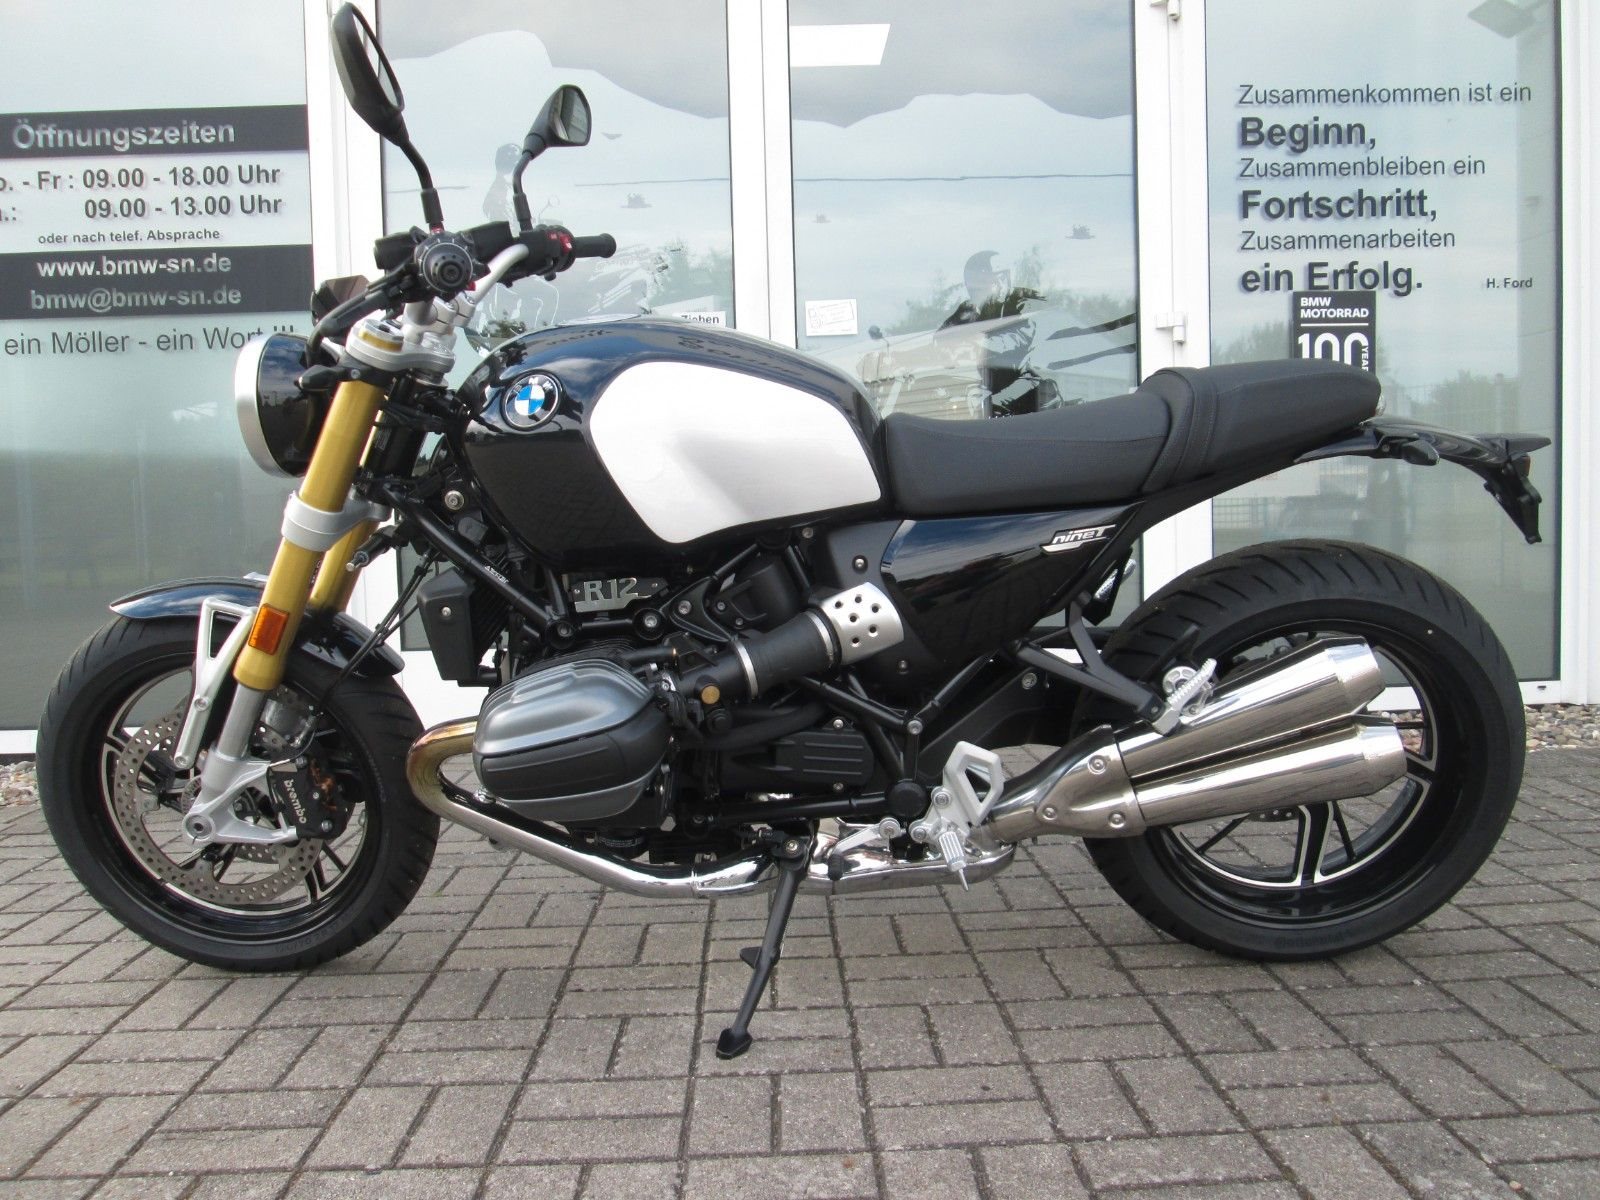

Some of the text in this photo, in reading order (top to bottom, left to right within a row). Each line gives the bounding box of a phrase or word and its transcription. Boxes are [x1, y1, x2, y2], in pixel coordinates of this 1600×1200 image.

[1238, 83, 1532, 105] Zusammenkommen ist ein
[13, 119, 235, 151] Öffnungszeiten
[1240, 116, 1377, 152] Beginn,
[82, 168, 145, 189] 09.00
[169, 165, 229, 186] 18.00
[237, 164, 281, 184] Uhr
[1239, 156, 1486, 178] Zusammenbleiben ein
[84, 198, 146, 219] 09.00
[171, 194, 231, 216] 13.00
[239, 194, 283, 214] Uhr
[1241, 188, 1437, 222] Fortschritt,
[38, 228, 220, 244] oder nach telef. Absprache
[1240, 229, 1456, 251] Zusammenarbeiten
[37, 253, 232, 278] www.bmw-sn.de
[1240, 261, 1423, 297] ein Erfolg.
[1486, 277, 1533, 289] H. Ford
[30, 285, 242, 313] bmw@bmw-sn.de
[1300, 296, 1331, 307] BMW
[1300, 307, 1369, 318] MOTORRAD
[4, 334, 42, 355] ein
[51, 330, 130, 354] Möller
[156, 330, 194, 351] ein
[1297, 332, 1369, 366] 100
[283, 778, 307, 824] brembo
